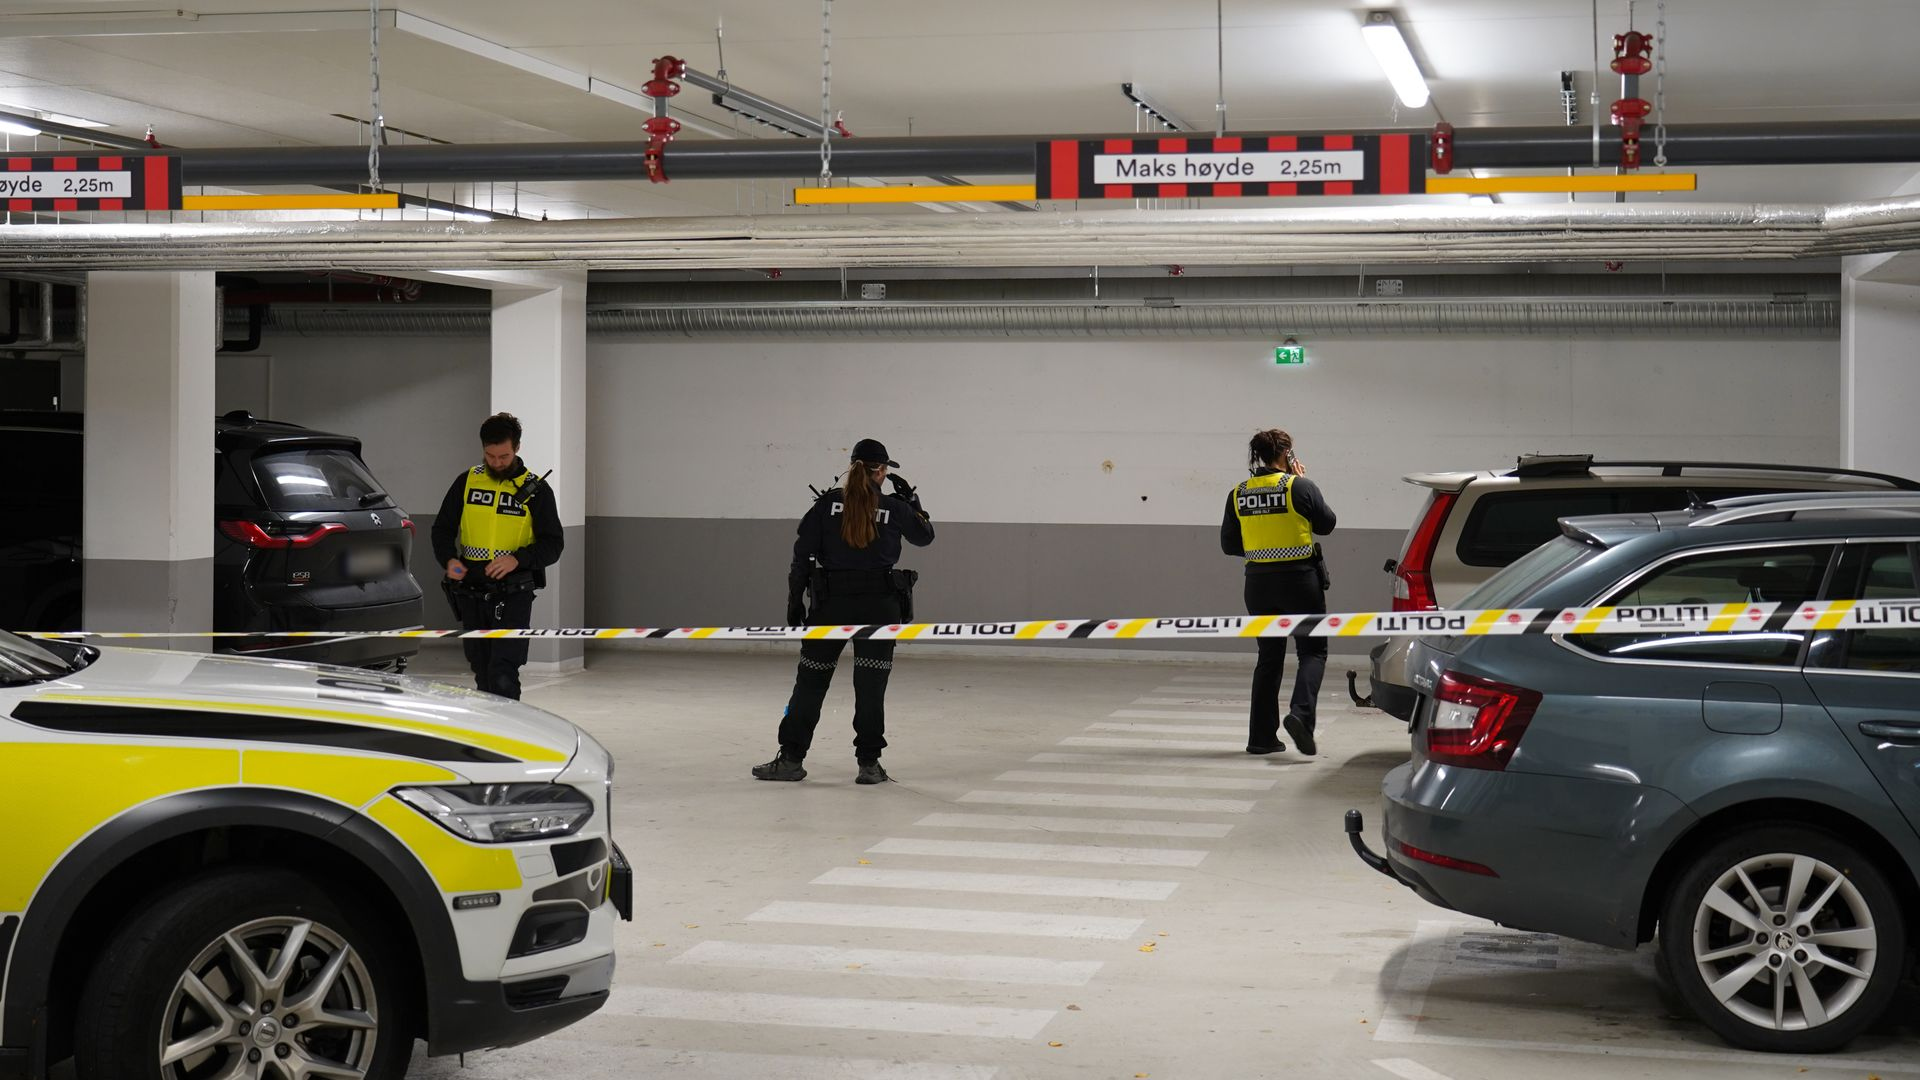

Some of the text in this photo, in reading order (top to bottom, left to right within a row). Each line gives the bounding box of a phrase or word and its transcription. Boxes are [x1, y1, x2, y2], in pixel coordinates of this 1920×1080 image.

[1116, 157, 1341, 181] Maks høyde 2,25m
[63, 178, 113, 195] 2,25m
[471, 490, 523, 509] POLI
[1237, 493, 1286, 510] POLITI
[831, 502, 889, 524] PTI
[1616, 606, 1708, 622] POLITI
[933, 623, 1016, 635] POLITI
[1156, 617, 1241, 629] POLITI
[1377, 616, 1465, 631] POLITI
